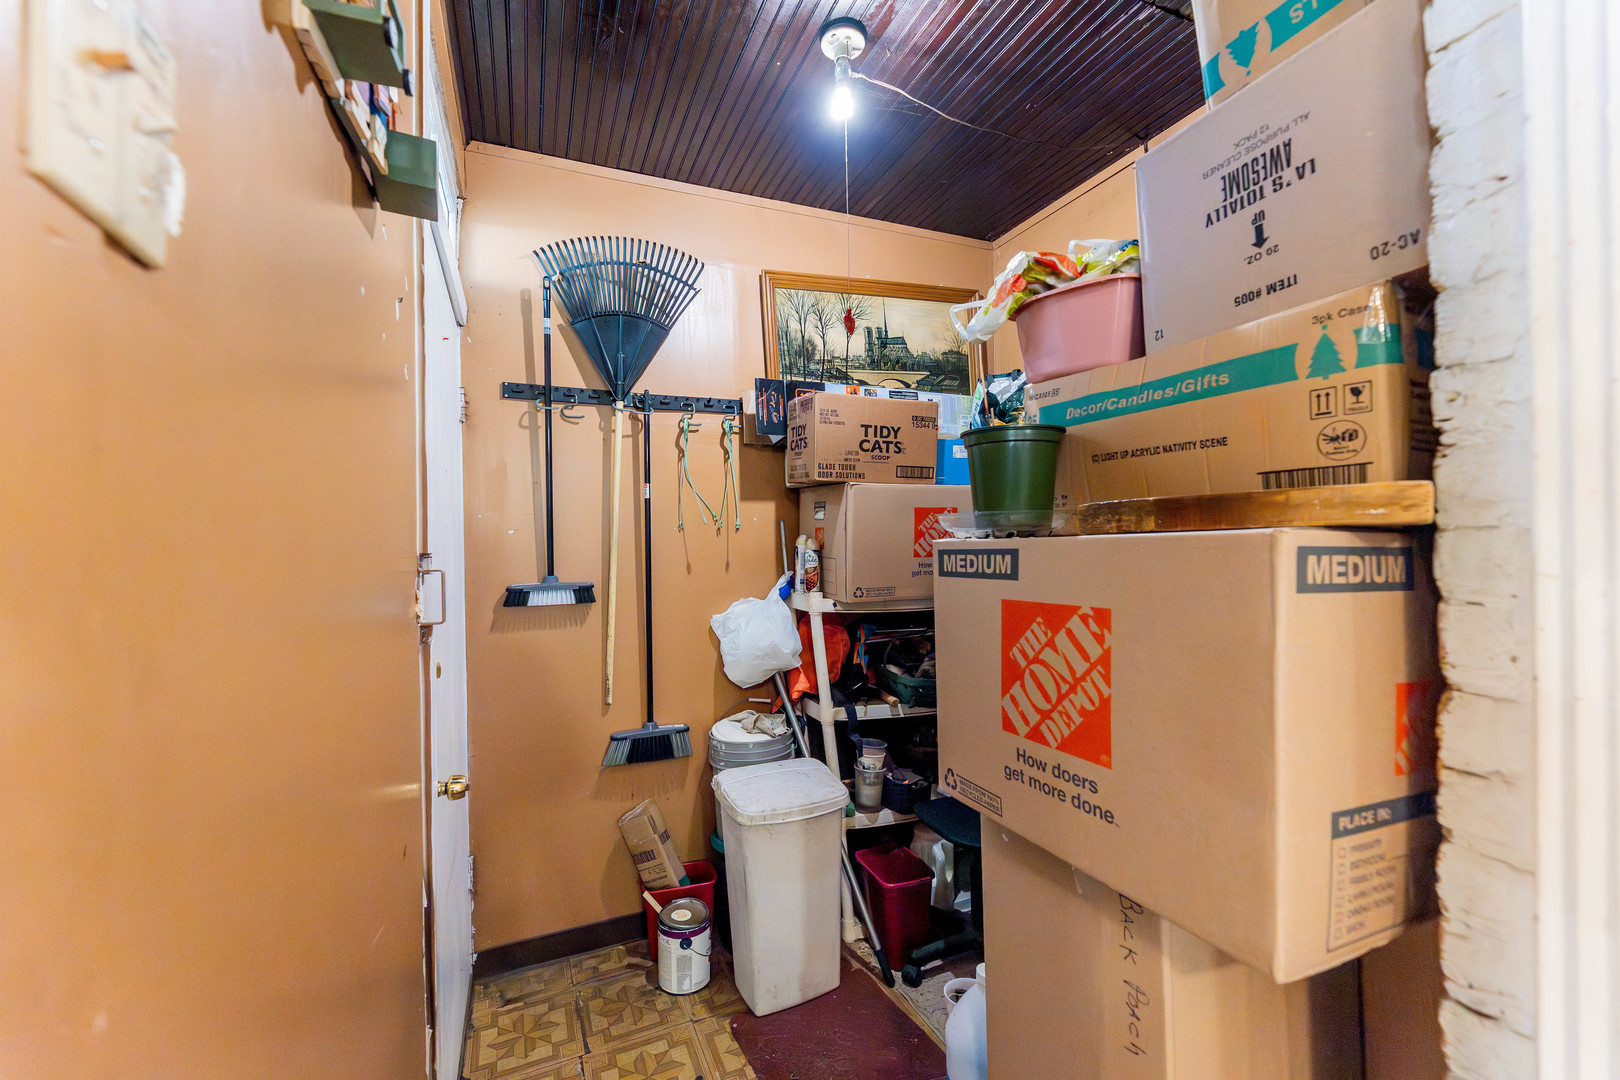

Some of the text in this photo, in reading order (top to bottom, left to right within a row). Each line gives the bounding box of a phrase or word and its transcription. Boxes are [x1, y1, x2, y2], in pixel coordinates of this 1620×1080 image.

[1202, 110, 1311, 180] ALL PURPOSE CLEANER
[1233, 132, 1257, 150] PACK
[1220, 138, 1293, 202] AWESOME
[1206, 187, 1266, 229] TOTALLY
[1251, 209, 1266, 226] UP
[1243, 243, 1280, 266] 20 OZ.
[1370, 228, 1421, 261] AC-20
[1233, 273, 1298, 308] ITEM #005
[1312, 312, 1334, 325] 3pk
[1154, 328, 1165, 342] 12
[1066, 373, 1230, 420] Decor/Candles/Gifts
[791, 423, 807, 438] TIDY
[860, 424, 901, 439] TIDY
[790, 437, 807, 452] CATS
[859, 439, 902, 454] CATS
[1101, 451, 1119, 462] LIGHT
[1120, 450, 1130, 460] UP
[1130, 445, 1161, 458] ACRYLIC
[1162, 440, 1198, 454] NATIVITY
[1199, 436, 1229, 449] SCENE
[817, 463, 836, 471] GLADE
[918, 512, 938, 532] THE
[942, 553, 1012, 576] MEDIUM
[1306, 554, 1406, 584] MEDIUM
[1009, 616, 1052, 670] THE
[1002, 605, 1111, 737] HOME
[1039, 664, 1112, 749] DEPOT
[1016, 747, 1099, 794] How doers
[1004, 765, 1024, 782] get
[1028, 774, 1067, 803] more
[1338, 810, 1375, 831] PLACE
[1119, 893, 1144, 965] BACK
